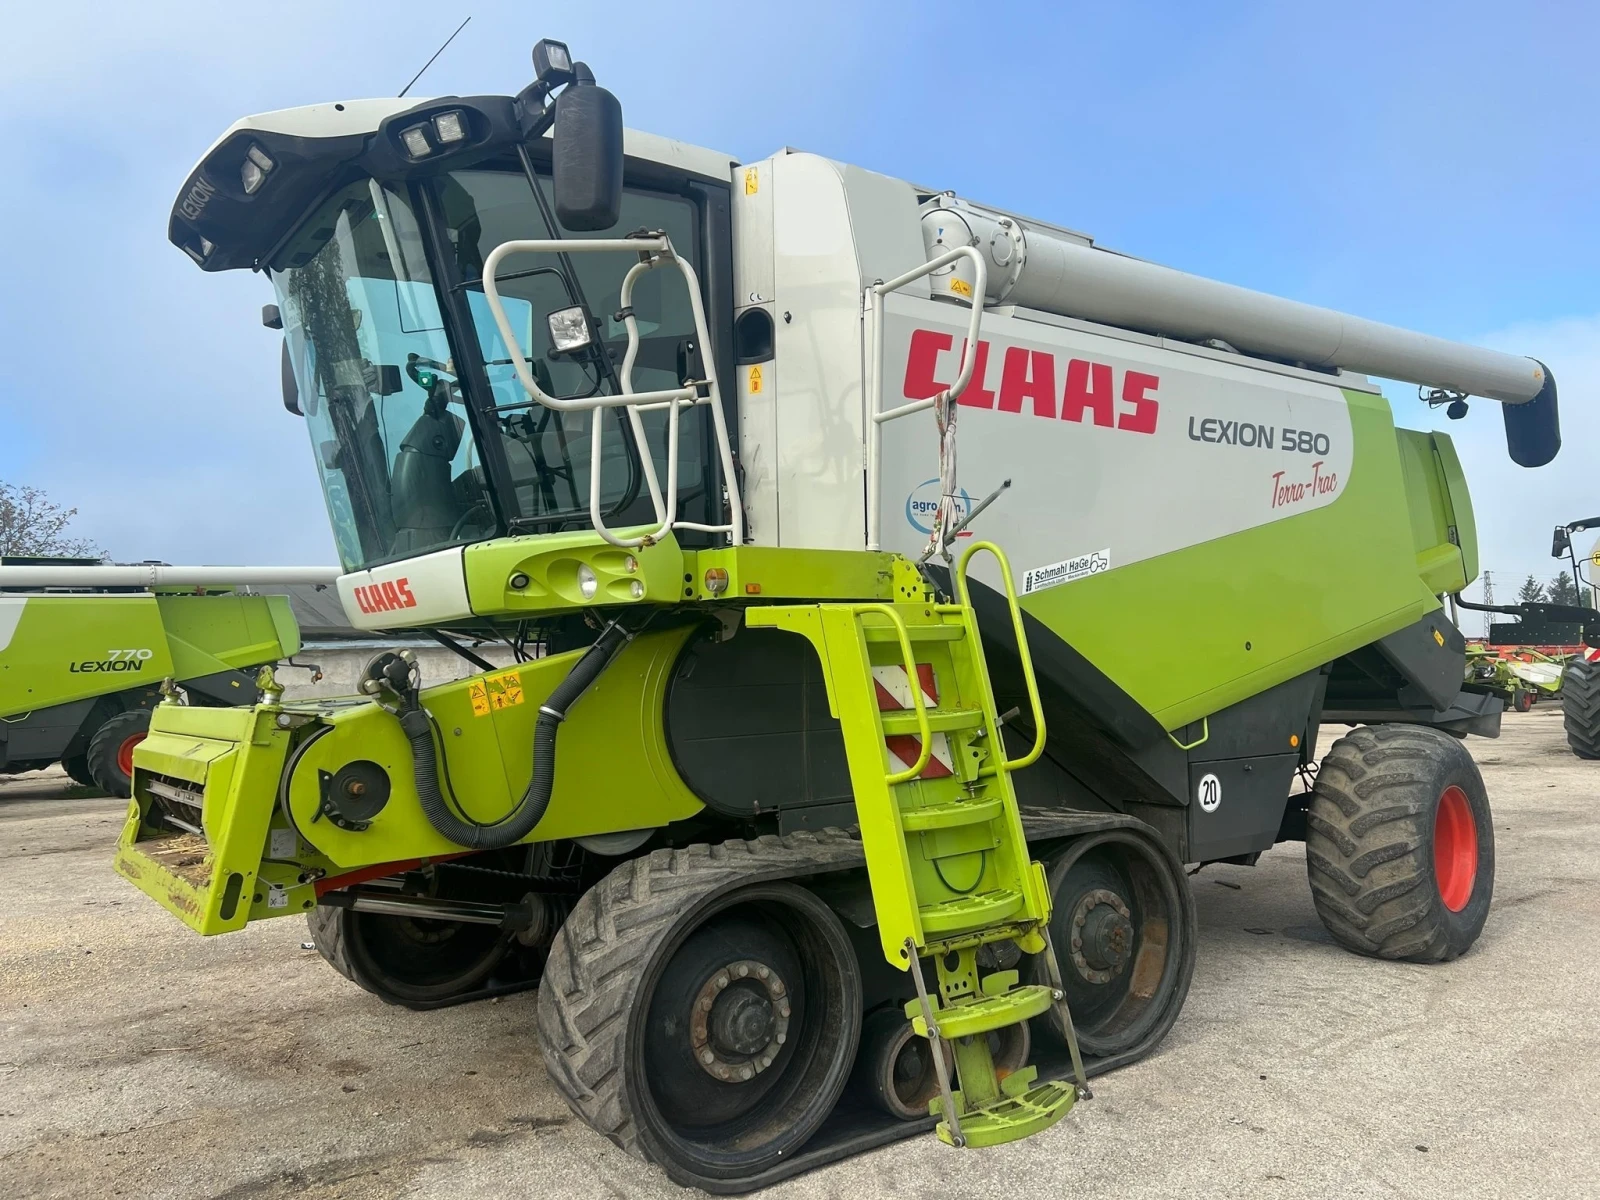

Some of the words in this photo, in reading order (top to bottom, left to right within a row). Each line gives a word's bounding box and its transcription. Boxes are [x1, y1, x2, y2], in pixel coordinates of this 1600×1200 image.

[179, 176, 216, 220] LEXION
[903, 328, 1160, 435] CLAAS
[1188, 416, 1275, 449] LEXION
[1281, 428, 1331, 456] 580
[1272, 461, 1338, 509] Terra-Trac
[1034, 563, 1067, 582] Schmahl
[1069, 558, 1090, 572] HaGe
[353, 577, 418, 614] CLAAS
[69, 659, 143, 673] LEXION
[107, 648, 153, 661] 770
[1202, 779, 1217, 805] 20
